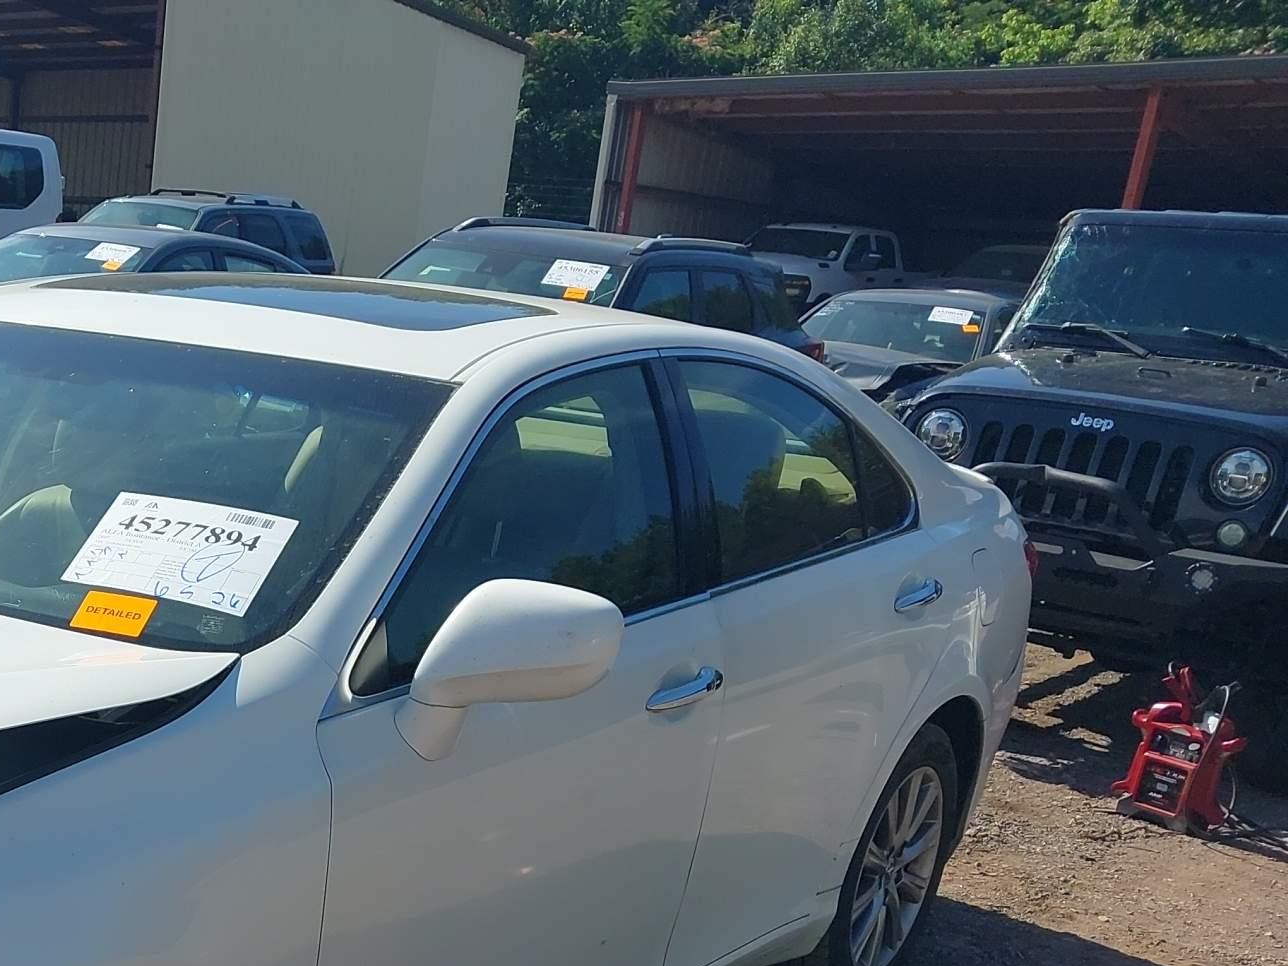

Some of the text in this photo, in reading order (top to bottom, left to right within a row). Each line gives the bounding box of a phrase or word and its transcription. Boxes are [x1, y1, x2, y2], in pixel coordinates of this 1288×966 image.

[1070, 412, 1114, 432] Jeep
[118, 514, 262, 552] 45277894
[85, 604, 142, 622] DETAILED
